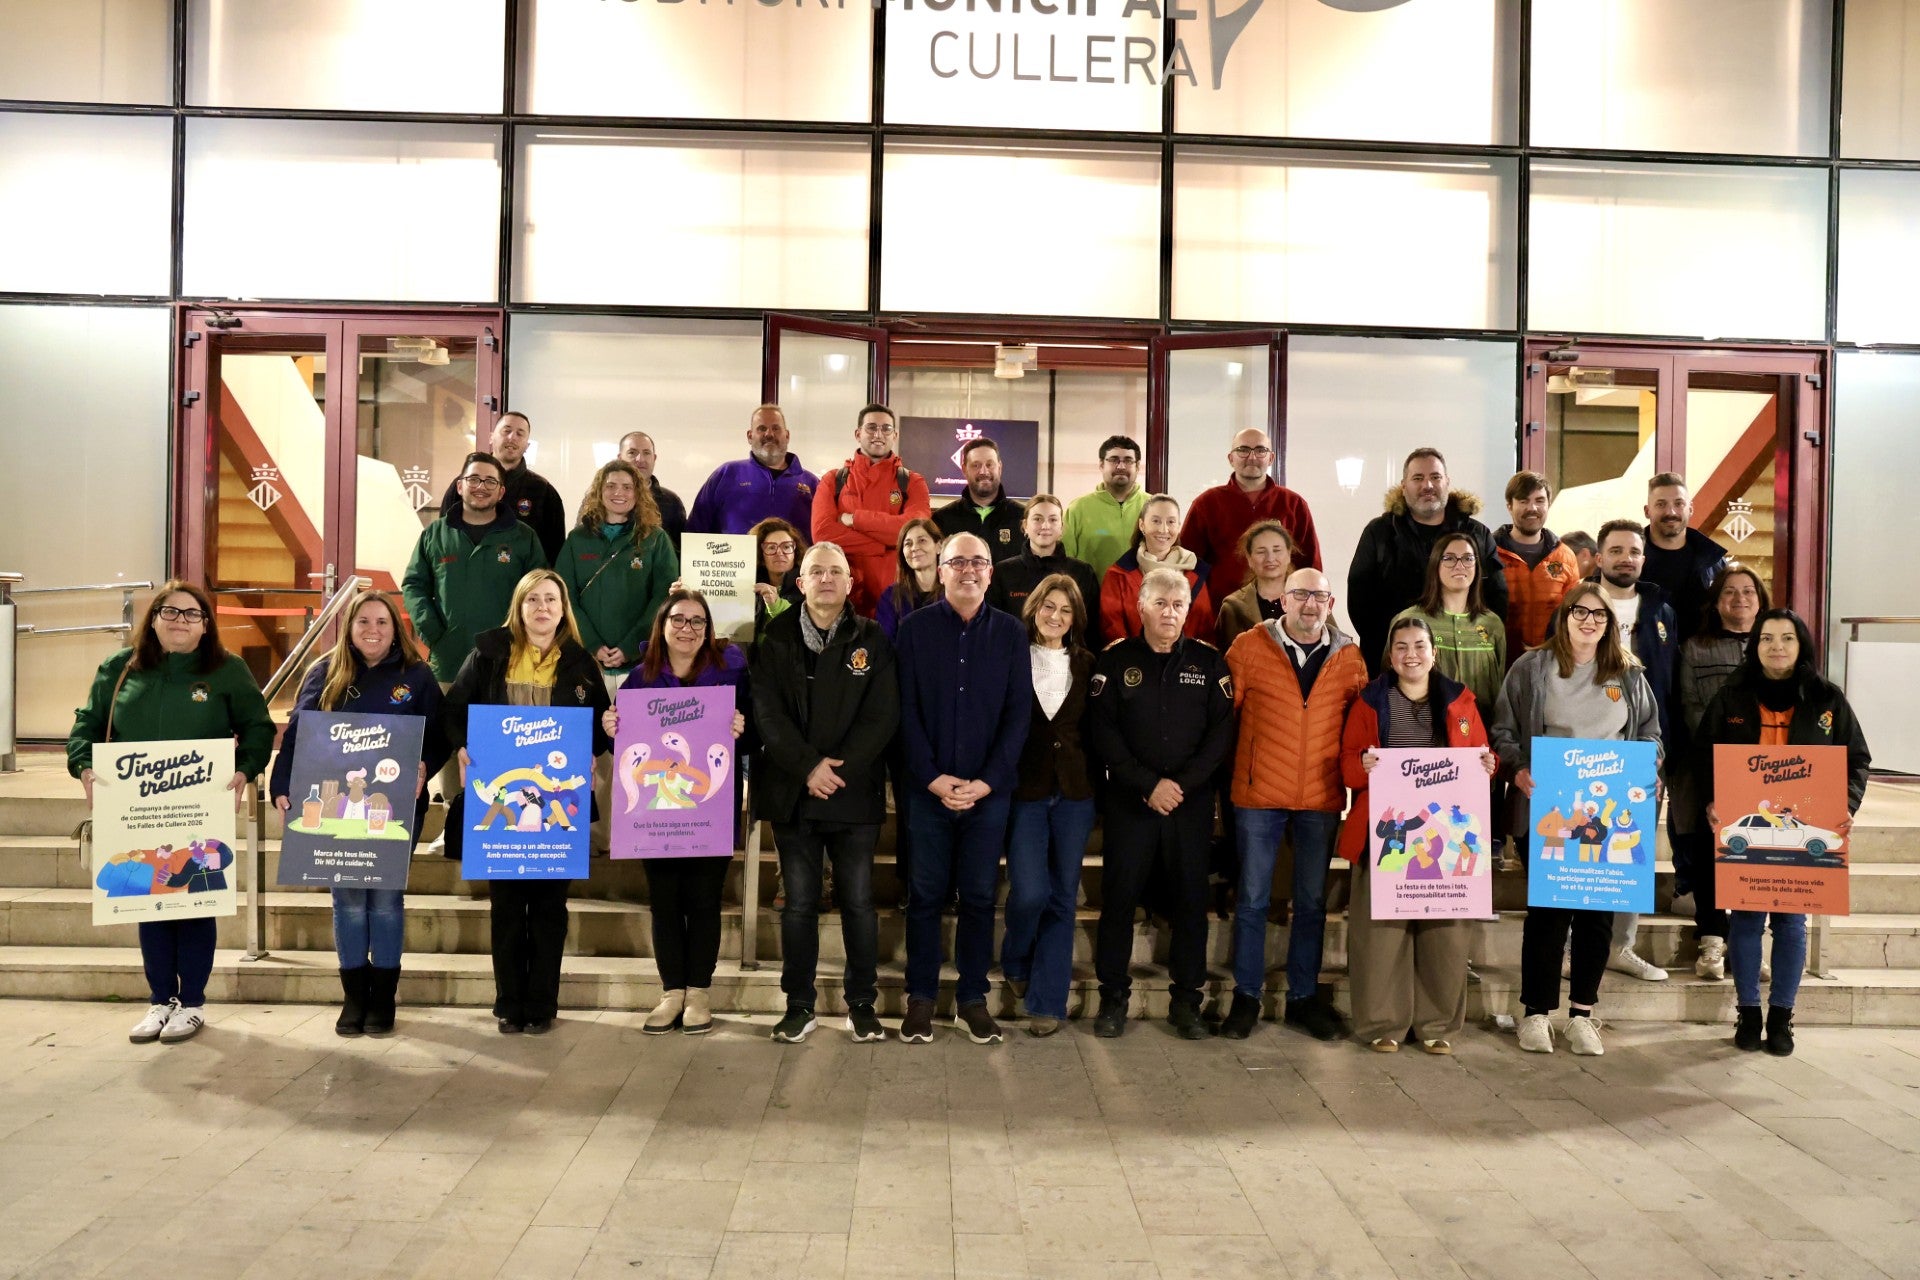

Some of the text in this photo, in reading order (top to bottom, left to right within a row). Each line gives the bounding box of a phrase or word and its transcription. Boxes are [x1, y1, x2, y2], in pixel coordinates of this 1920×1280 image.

[930, 30, 1198, 86] CULLERA
[711, 560, 746, 568] COMISSIÓ
[647, 697, 700, 716] Tingues
[660, 704, 705, 727] trellat!
[330, 723, 387, 741] Tingues
[502, 716, 557, 735] Tingues
[342, 733, 391, 754] trellat!
[515, 726, 563, 747] trellat!
[116, 750, 203, 780] Tingues
[1400, 758, 1454, 777] Tingues
[1563, 749, 1618, 768] Tingues
[1747, 754, 1806, 773] Tingues
[379, 767, 398, 776] NO
[1415, 766, 1459, 789] trellat!
[1577, 759, 1625, 780] trellat!
[1763, 764, 1813, 784] trellat!
[139, 762, 213, 797] trellat!
[1556, 874, 1585, 883] participar
